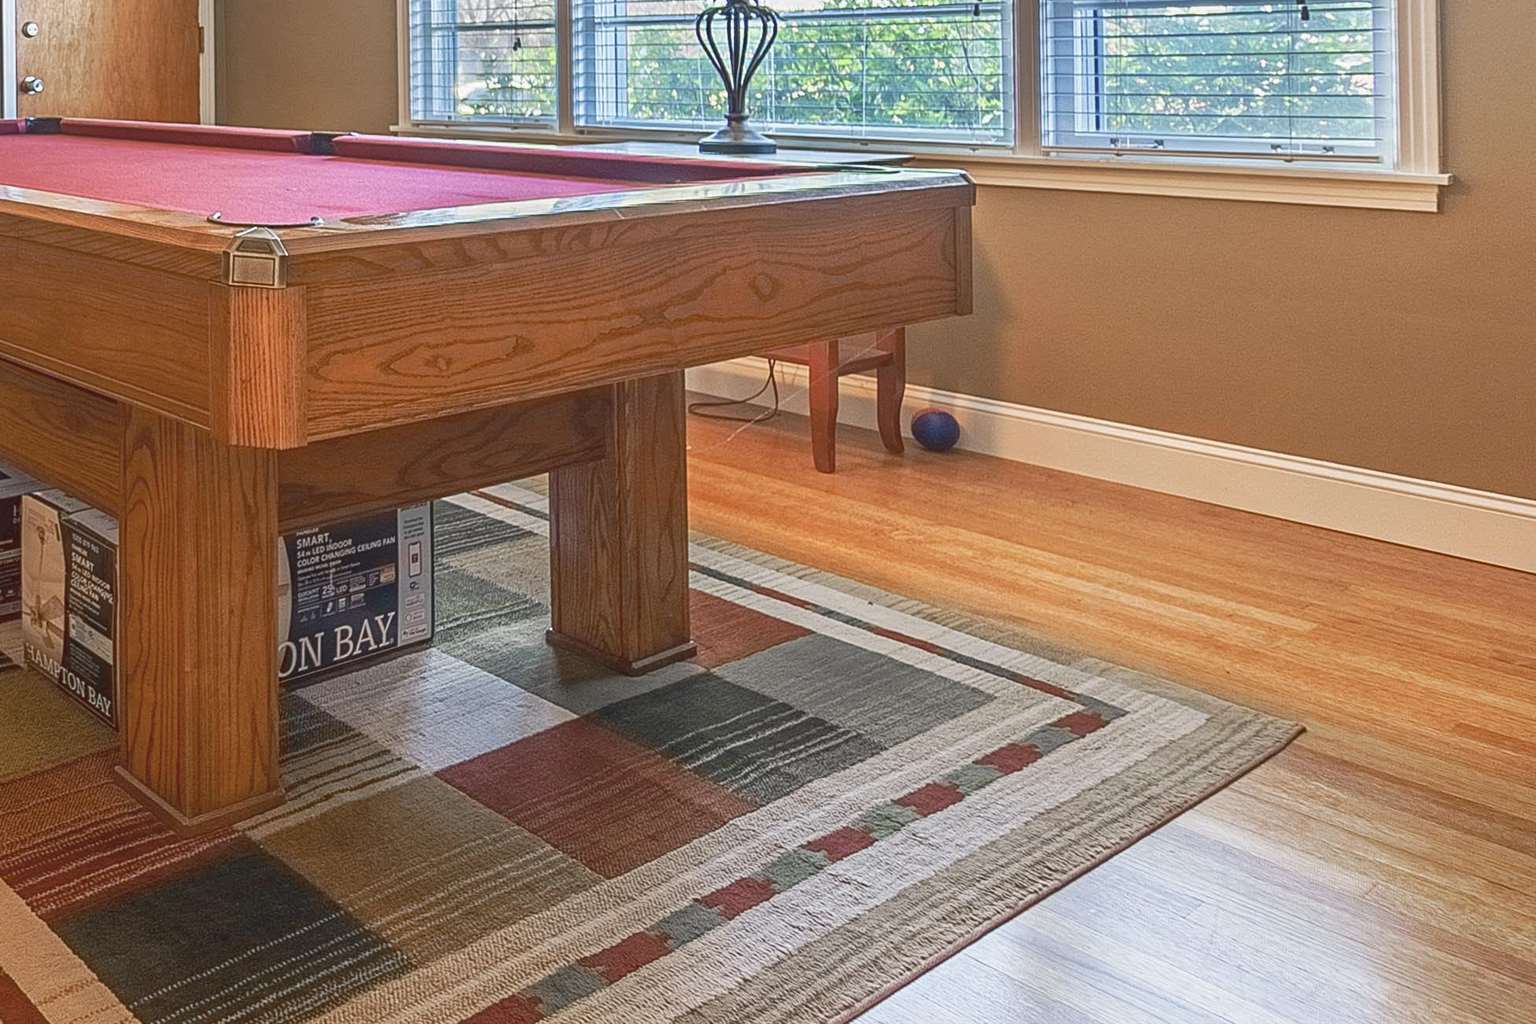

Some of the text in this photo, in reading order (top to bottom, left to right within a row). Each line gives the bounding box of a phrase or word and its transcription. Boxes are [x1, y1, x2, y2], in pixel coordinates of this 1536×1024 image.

[296, 555, 320, 568] COLOR
[320, 546, 357, 563] CHANGING
[356, 539, 382, 553] CEILING
[382, 535, 396, 547] FAN
[312, 546, 325, 556] LED
[326, 538, 353, 552] INDOOR
[332, 611, 397, 662] BAY
[24, 642, 85, 698] HAMPTON
[87, 685, 111, 717] BAY
